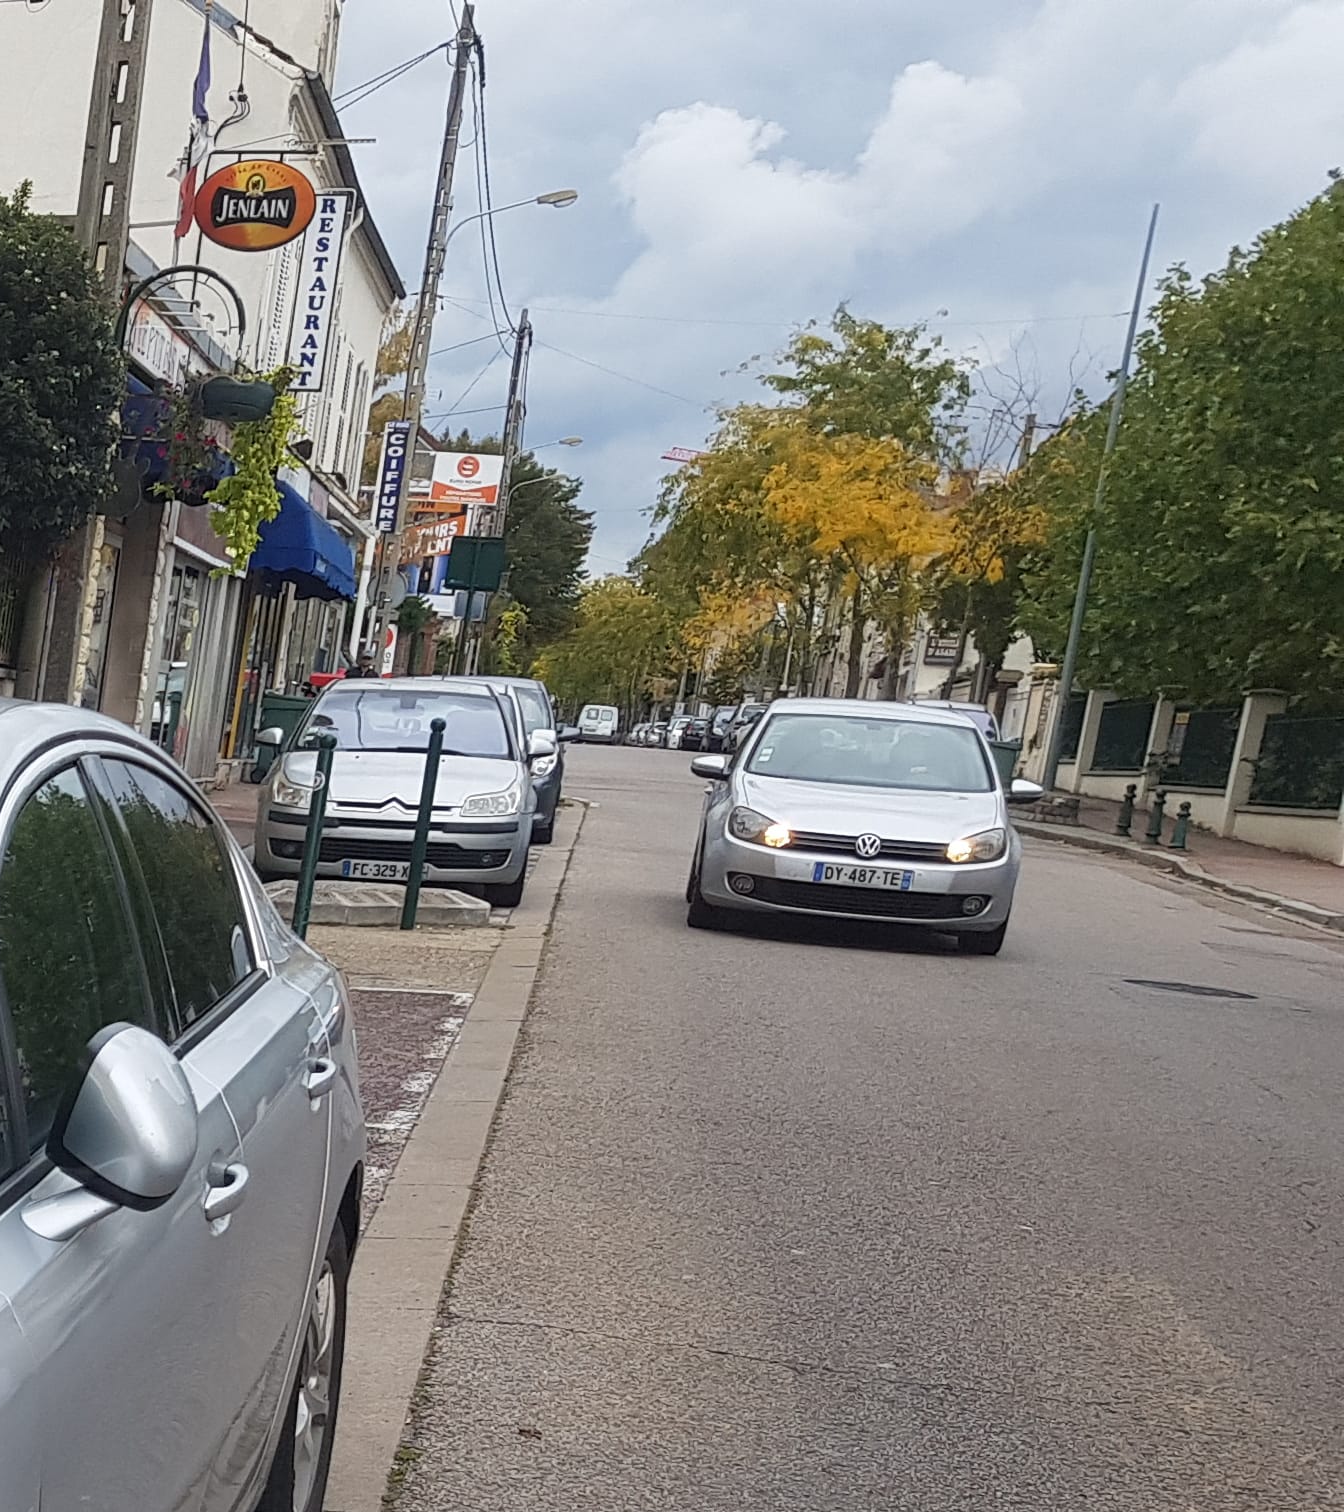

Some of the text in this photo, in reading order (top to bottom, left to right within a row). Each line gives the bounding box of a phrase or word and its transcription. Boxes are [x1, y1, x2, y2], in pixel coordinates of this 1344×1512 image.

[216, 195, 290, 223] JENLAIN
[297, 198, 337, 387] RESTAURANT
[378, 433, 406, 532] COIFFURE
[353, 862, 428, 878] FC-329-X
[824, 866, 901, 887] DY-487-TE
